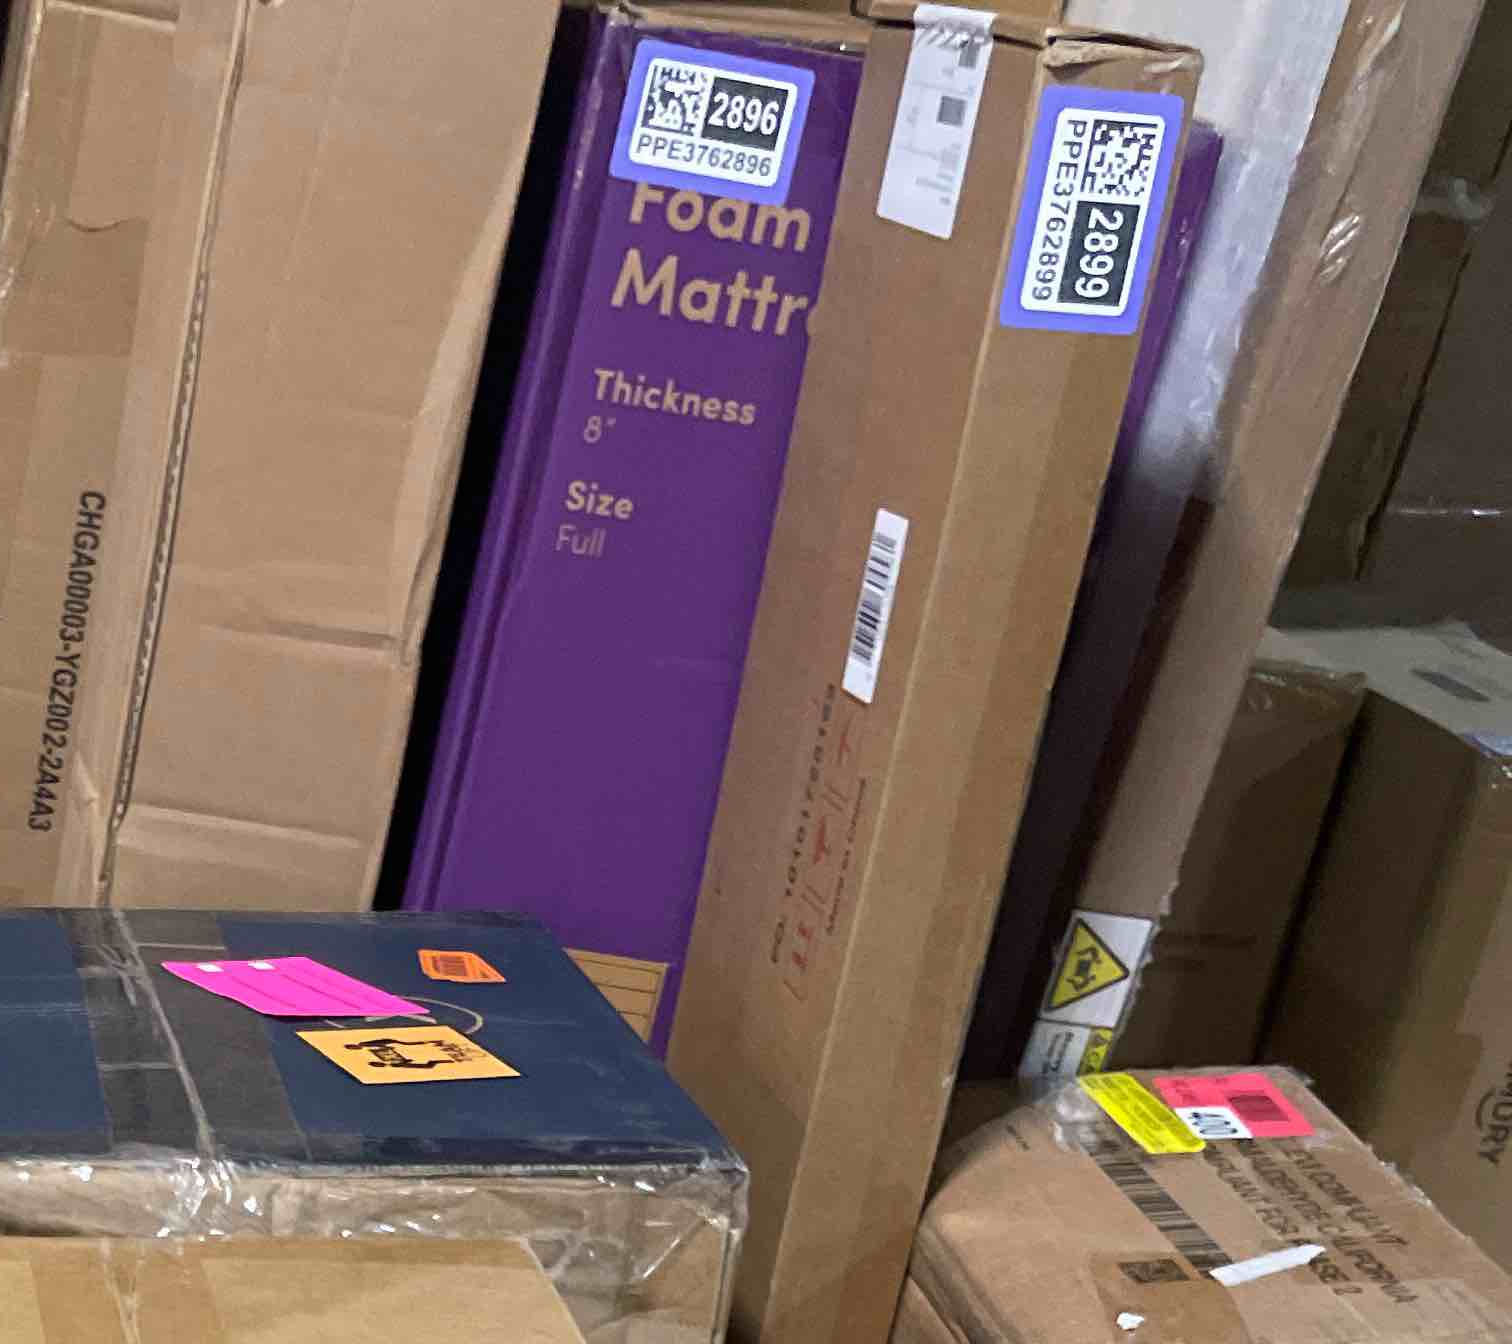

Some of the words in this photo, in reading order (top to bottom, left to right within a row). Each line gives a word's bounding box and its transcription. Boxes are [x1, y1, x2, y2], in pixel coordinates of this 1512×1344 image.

[707, 89, 780, 137] 2896
[635, 133, 773, 178] PPE3762896
[629, 182, 810, 252] Foam
[1029, 119, 1087, 303] PPE3762899
[1073, 207, 1125, 299] 2899
[611, 249, 815, 338] Mattr
[594, 368, 757, 427] Thickness
[564, 481, 634, 521] Size
[554, 525, 606, 559] Full
[28, 490, 107, 833] CHGA00003-YGZ002-2A4A3
